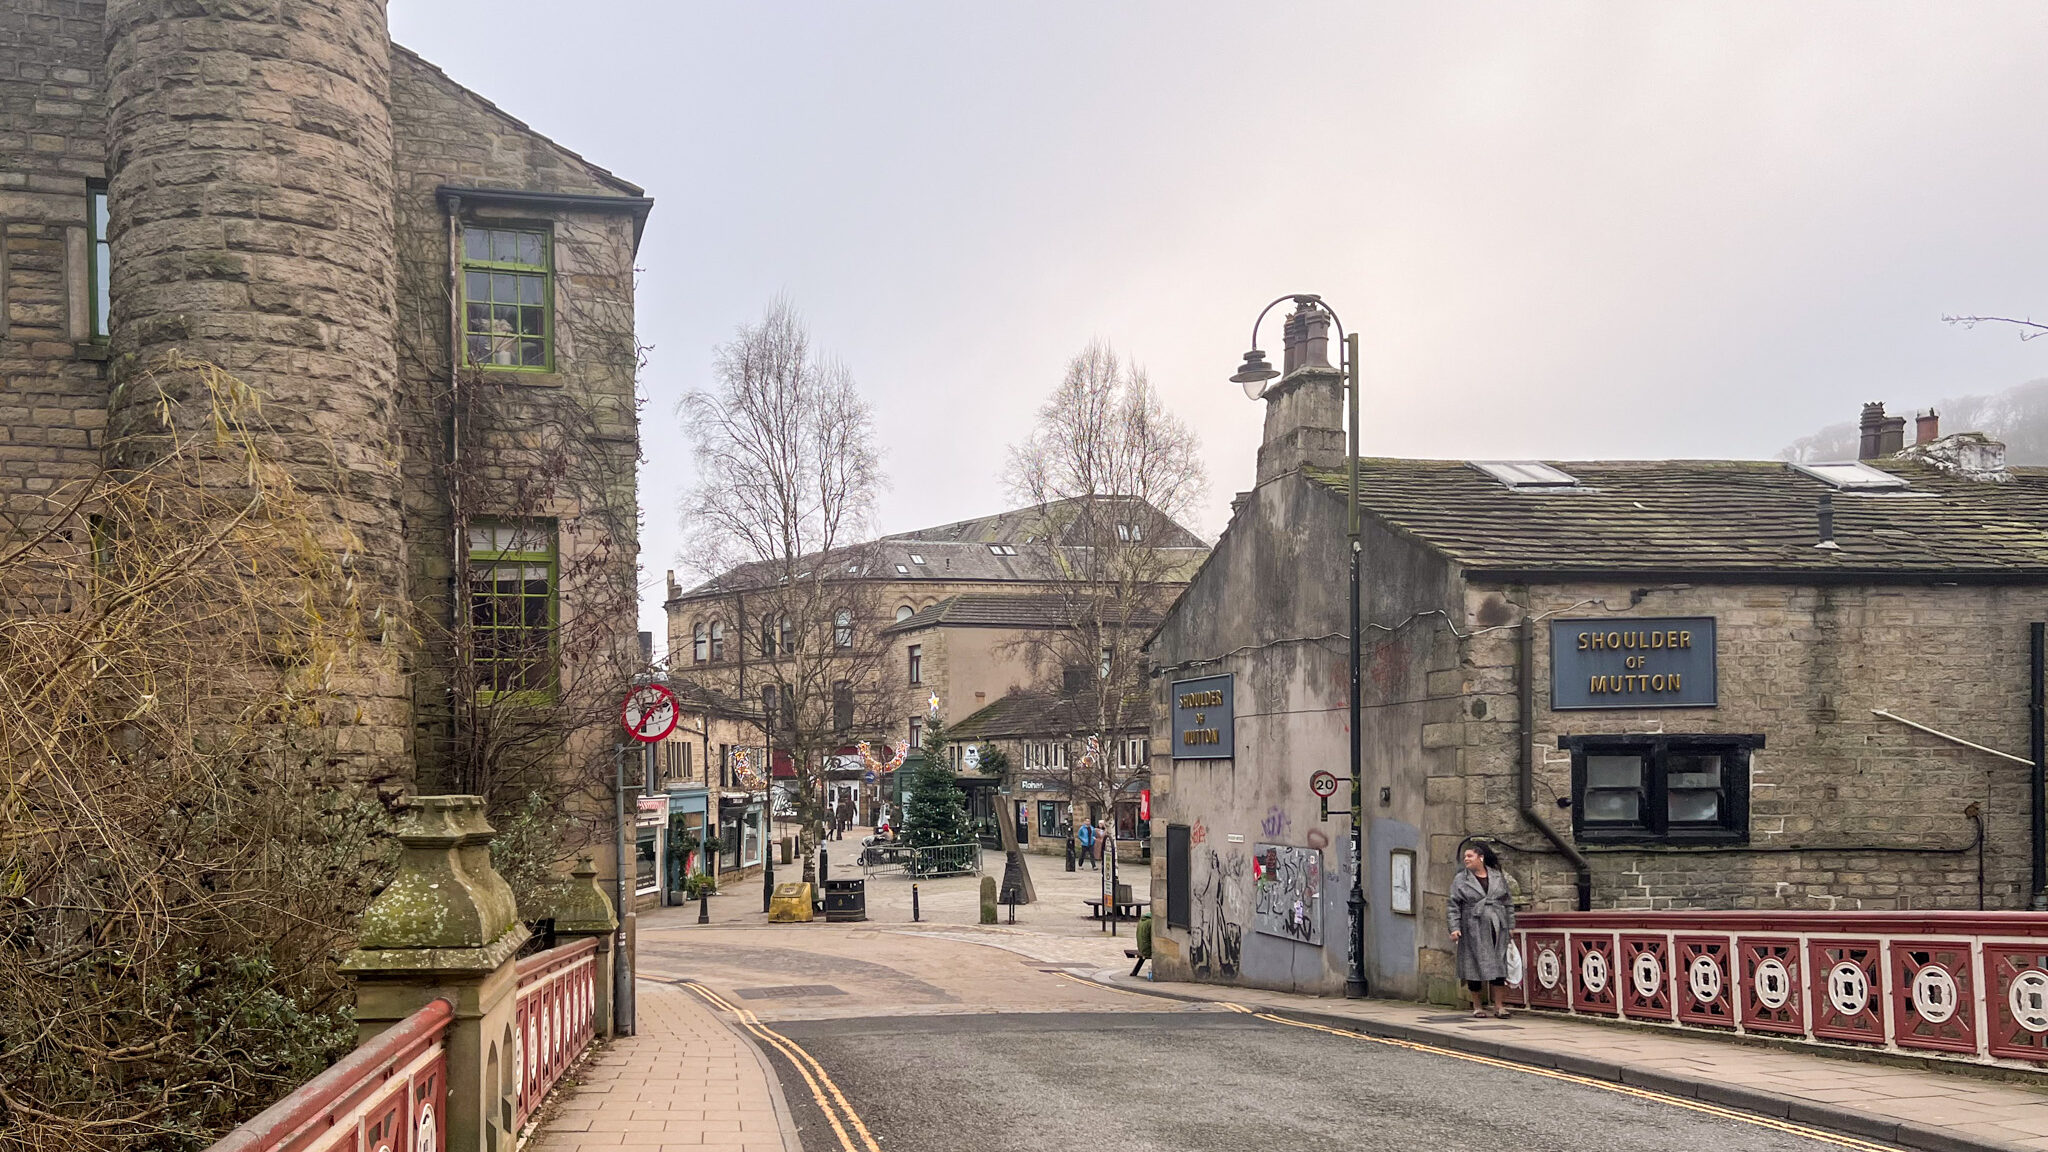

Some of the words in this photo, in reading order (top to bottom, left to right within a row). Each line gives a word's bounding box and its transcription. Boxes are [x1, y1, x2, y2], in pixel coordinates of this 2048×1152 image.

[1578, 631, 1691, 650] SHOULDER
[1626, 656, 1645, 669] OF
[1591, 674, 1681, 693] MUTTON
[1179, 689, 1222, 709] SHOULDER
[1184, 728, 1219, 744] MUTTON
[1316, 779, 1334, 790] 20
